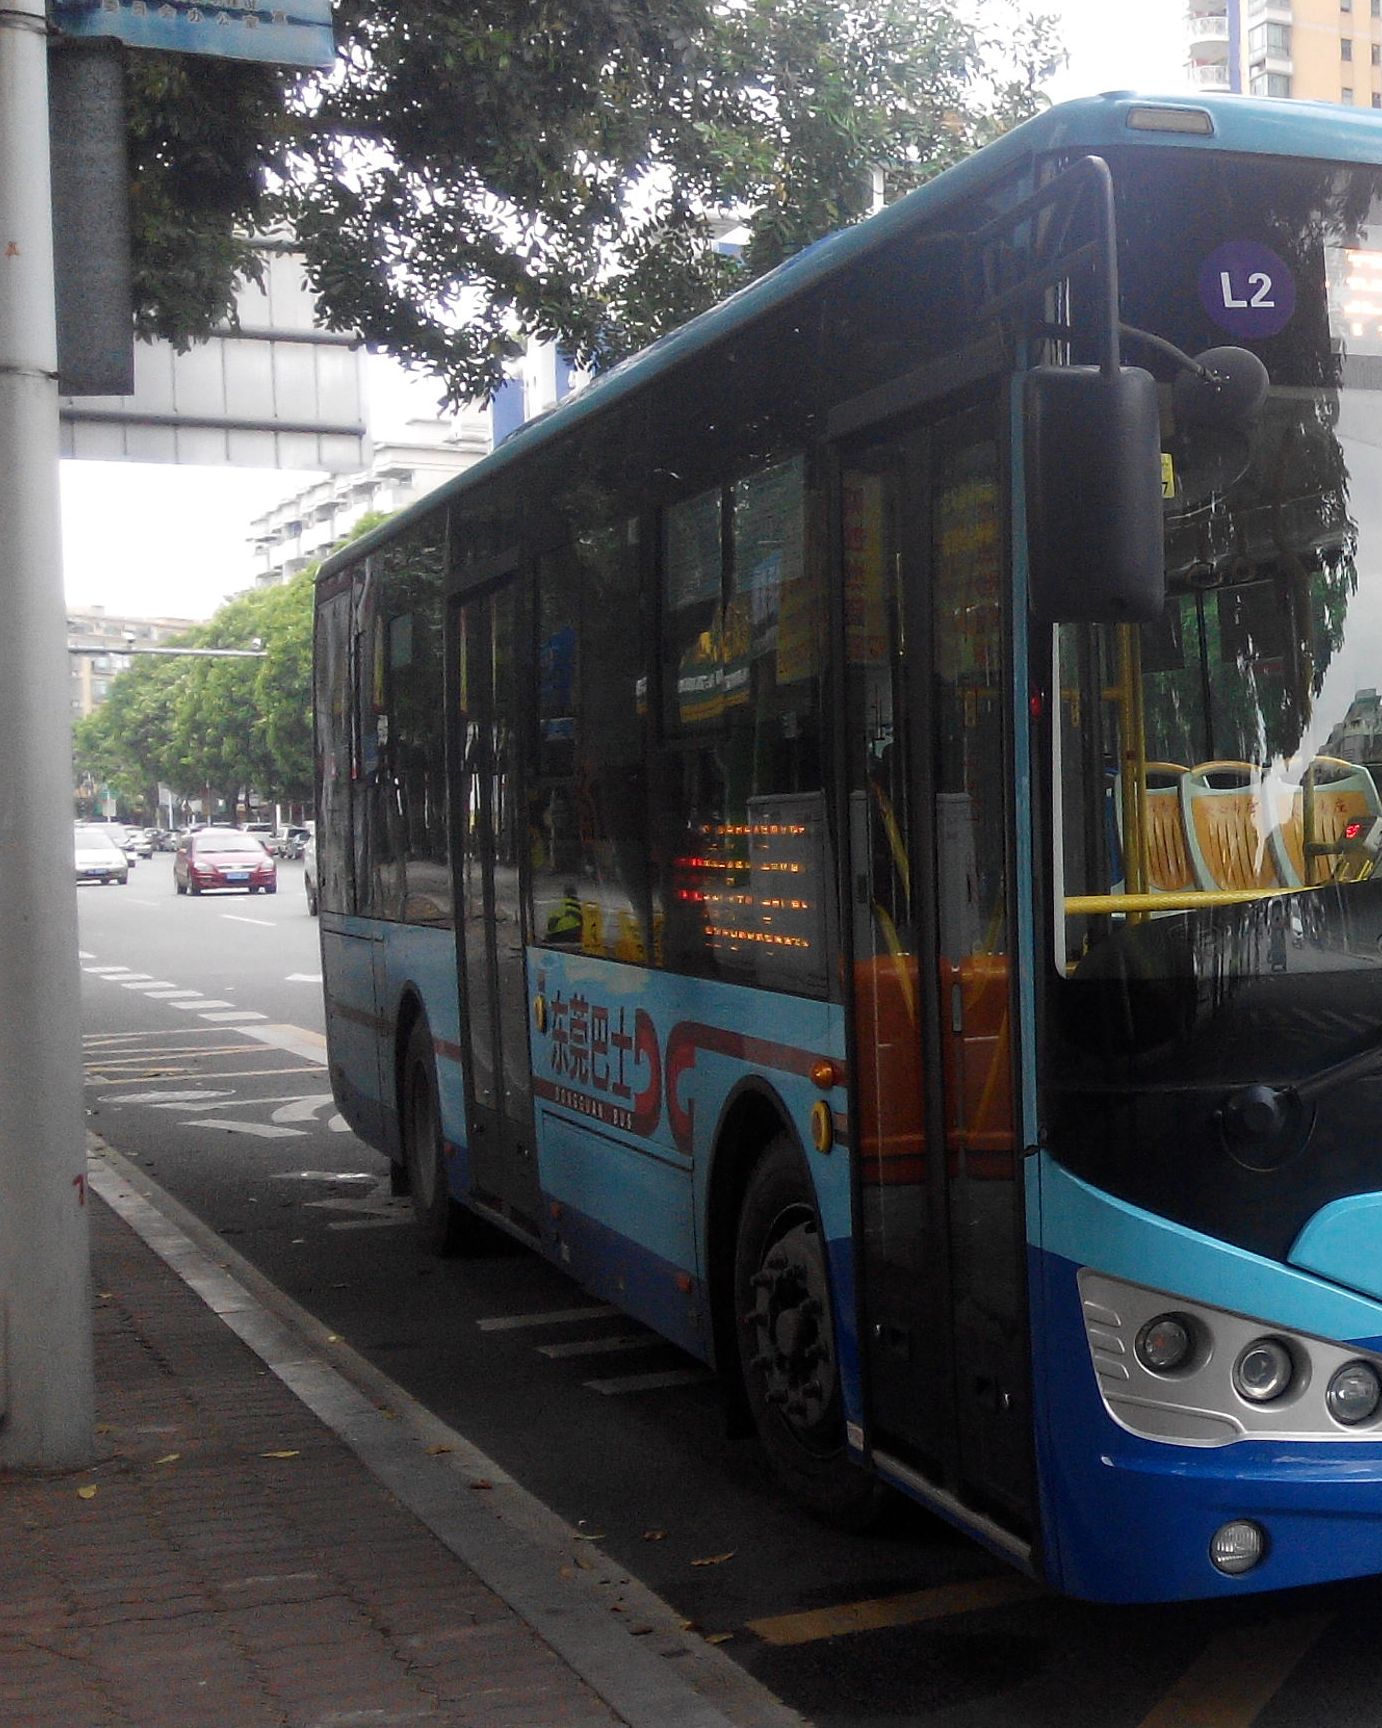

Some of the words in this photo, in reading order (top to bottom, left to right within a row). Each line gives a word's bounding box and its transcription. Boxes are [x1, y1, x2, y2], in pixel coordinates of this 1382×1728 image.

[1220, 271, 1275, 308] L2
[551, 990, 632, 1099] 东莞巴士
[613, 1108, 632, 1130] BUS
